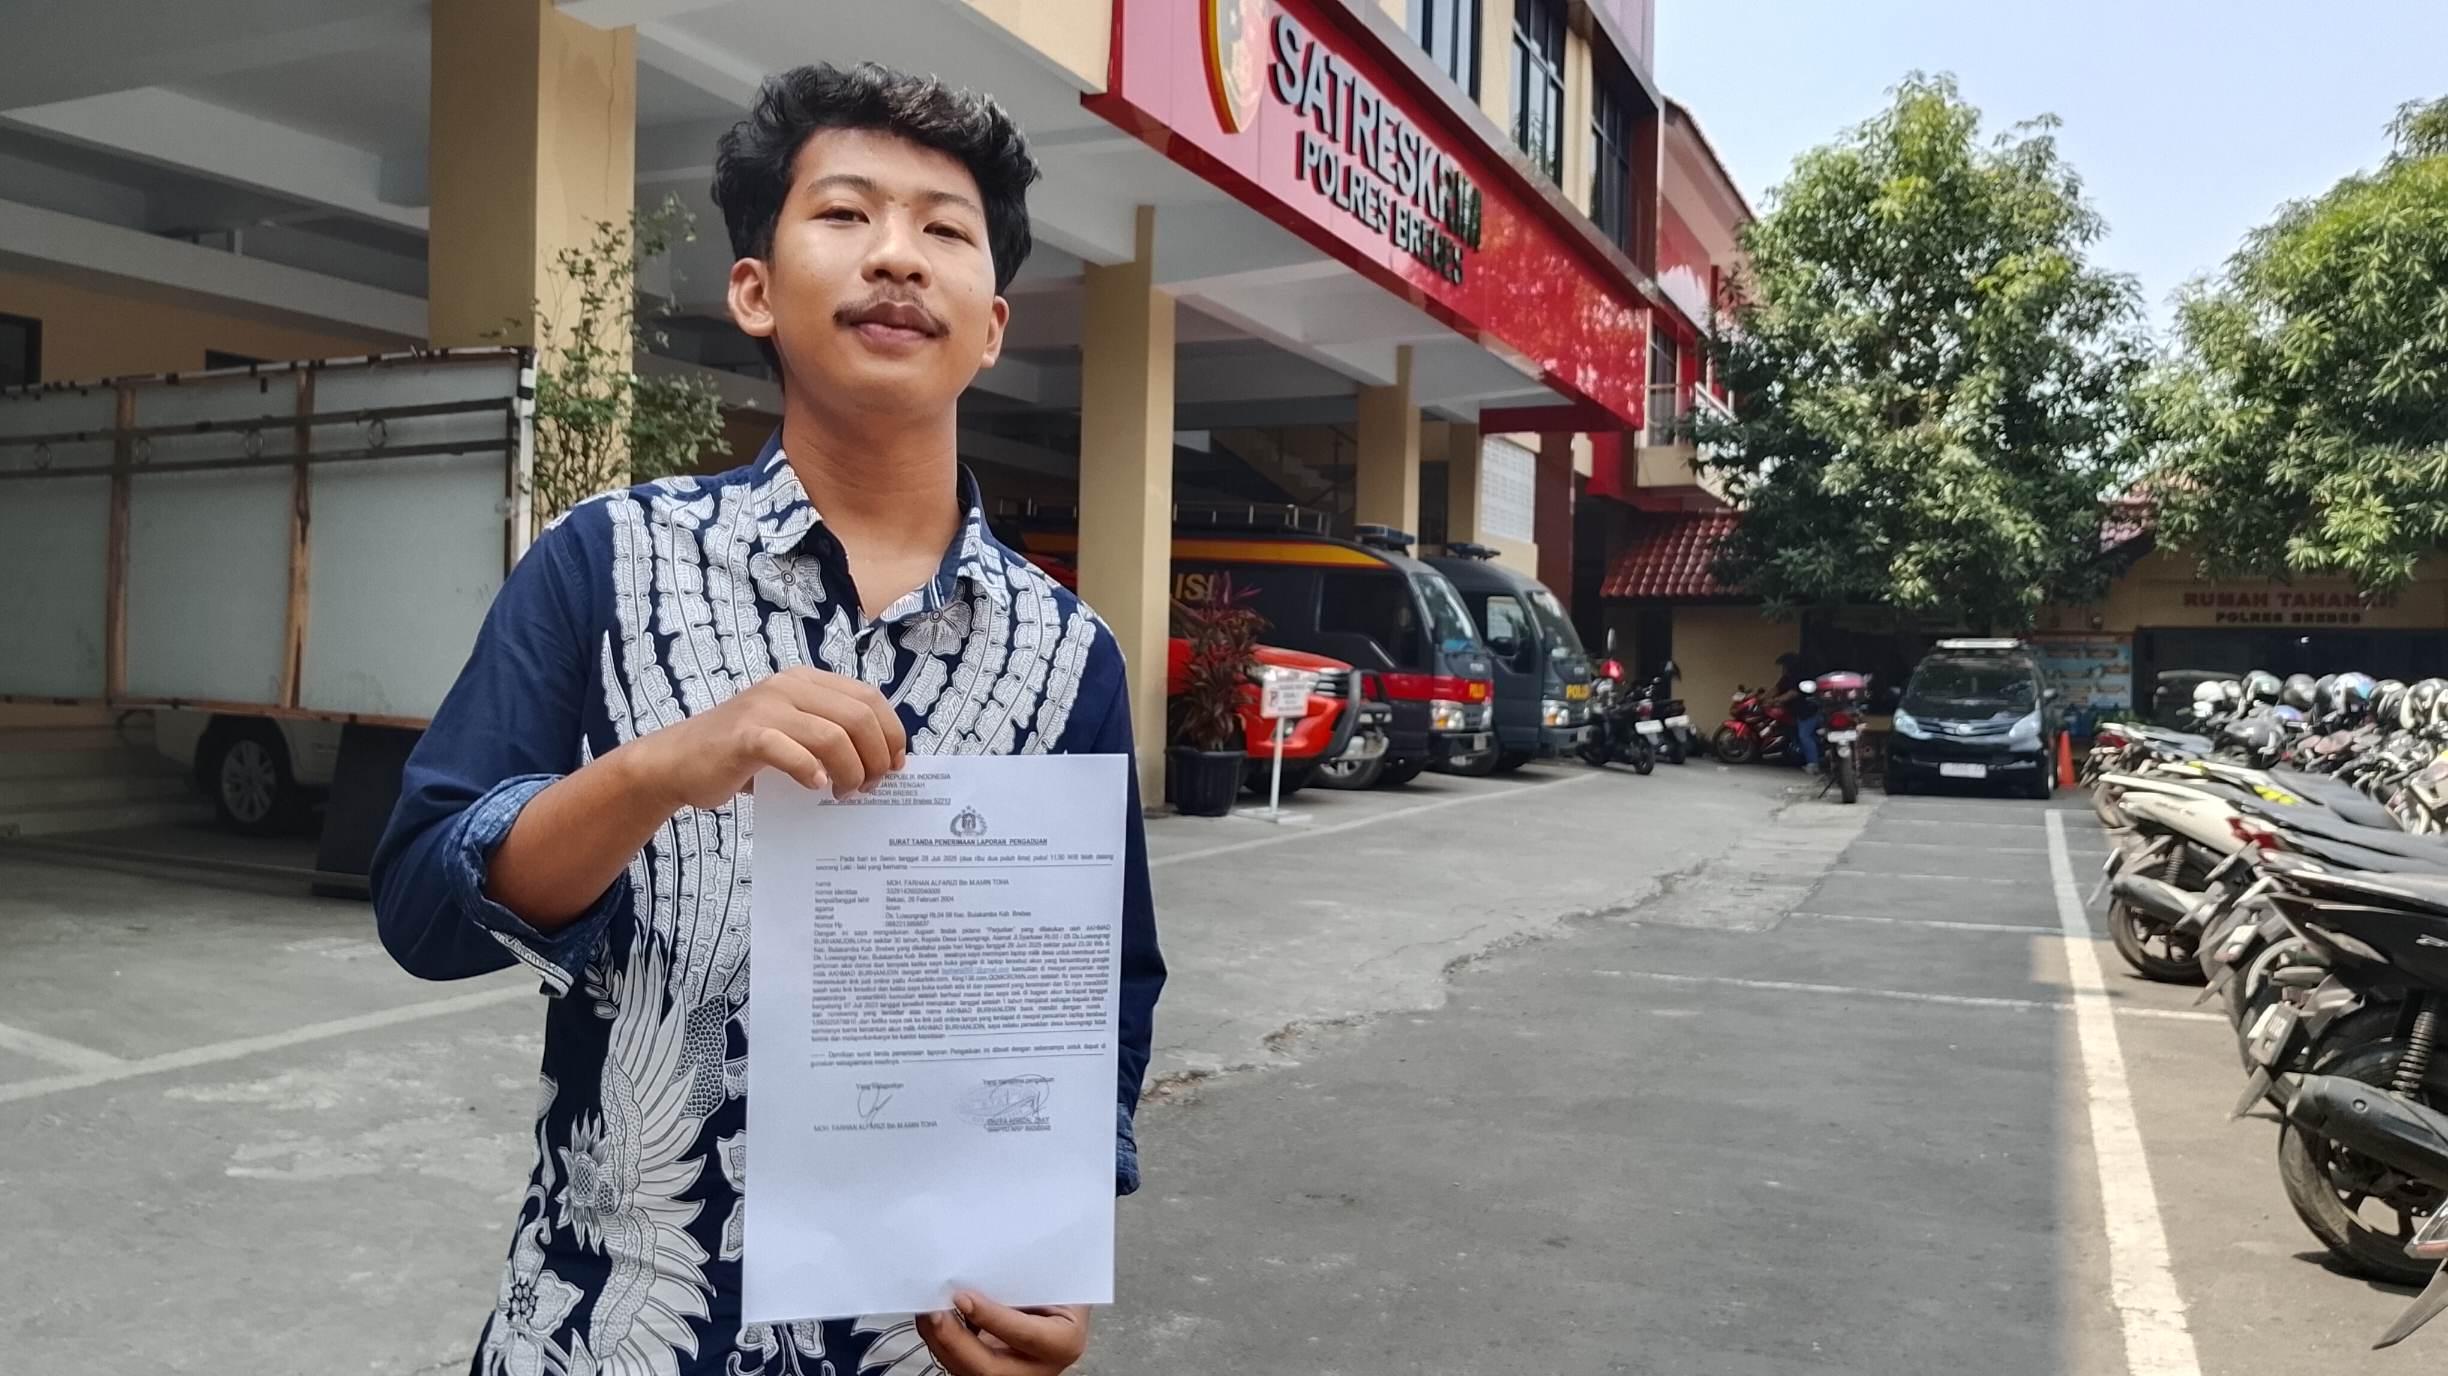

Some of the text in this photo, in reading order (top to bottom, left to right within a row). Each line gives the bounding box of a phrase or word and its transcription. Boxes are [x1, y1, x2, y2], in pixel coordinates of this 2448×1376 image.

[1297, 130, 1463, 286] POLRES BREBES
[2184, 592, 2268, 608] RUMAH
[2215, 612, 2361, 624] POLRES BREBES
[977, 838, 1007, 846] LAPORAN
[1009, 838, 1047, 846] PENGADUAN
